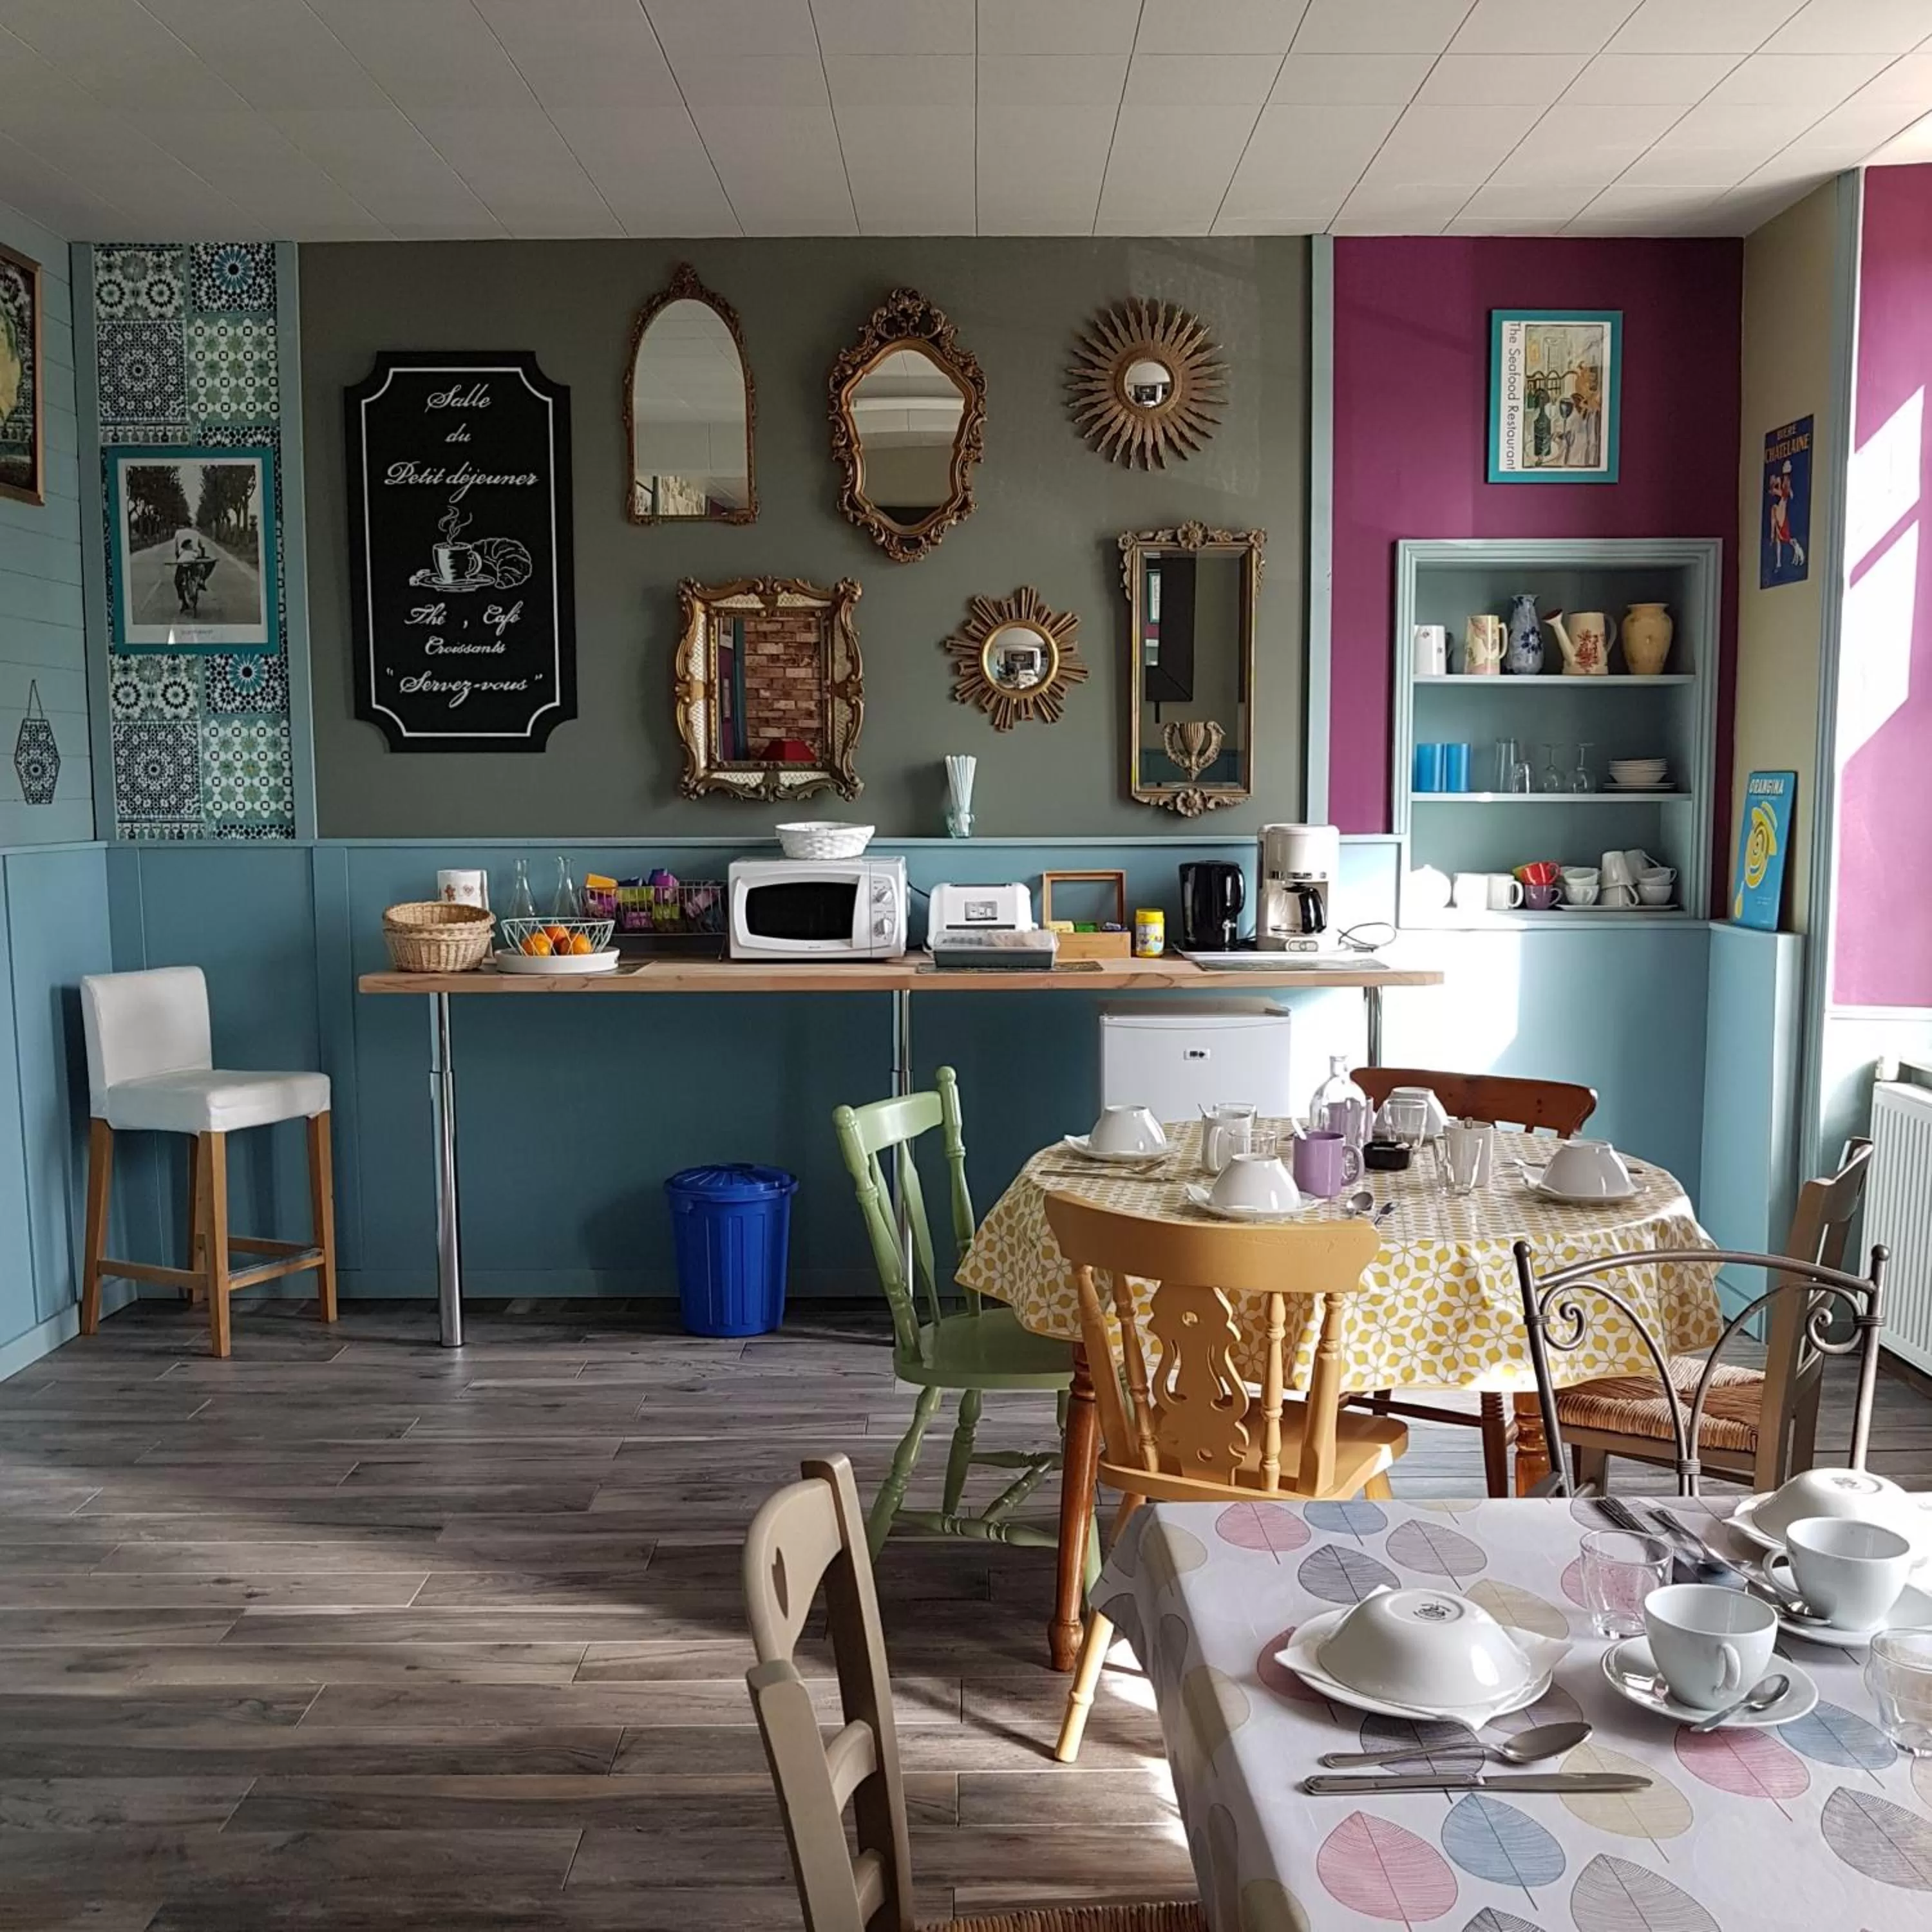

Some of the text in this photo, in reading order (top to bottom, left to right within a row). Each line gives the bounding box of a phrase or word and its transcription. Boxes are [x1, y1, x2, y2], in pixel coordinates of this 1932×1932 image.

[1510, 321, 1522, 343] The
[1508, 348, 1522, 401] Seafood
[424, 383, 491, 412] Salle
[444, 422, 471, 442] du
[384, 460, 539, 503] Petit déjeuner
[404, 602, 447, 625] Thé
[484, 600, 524, 636] Café
[424, 636, 506, 655] Croissants
